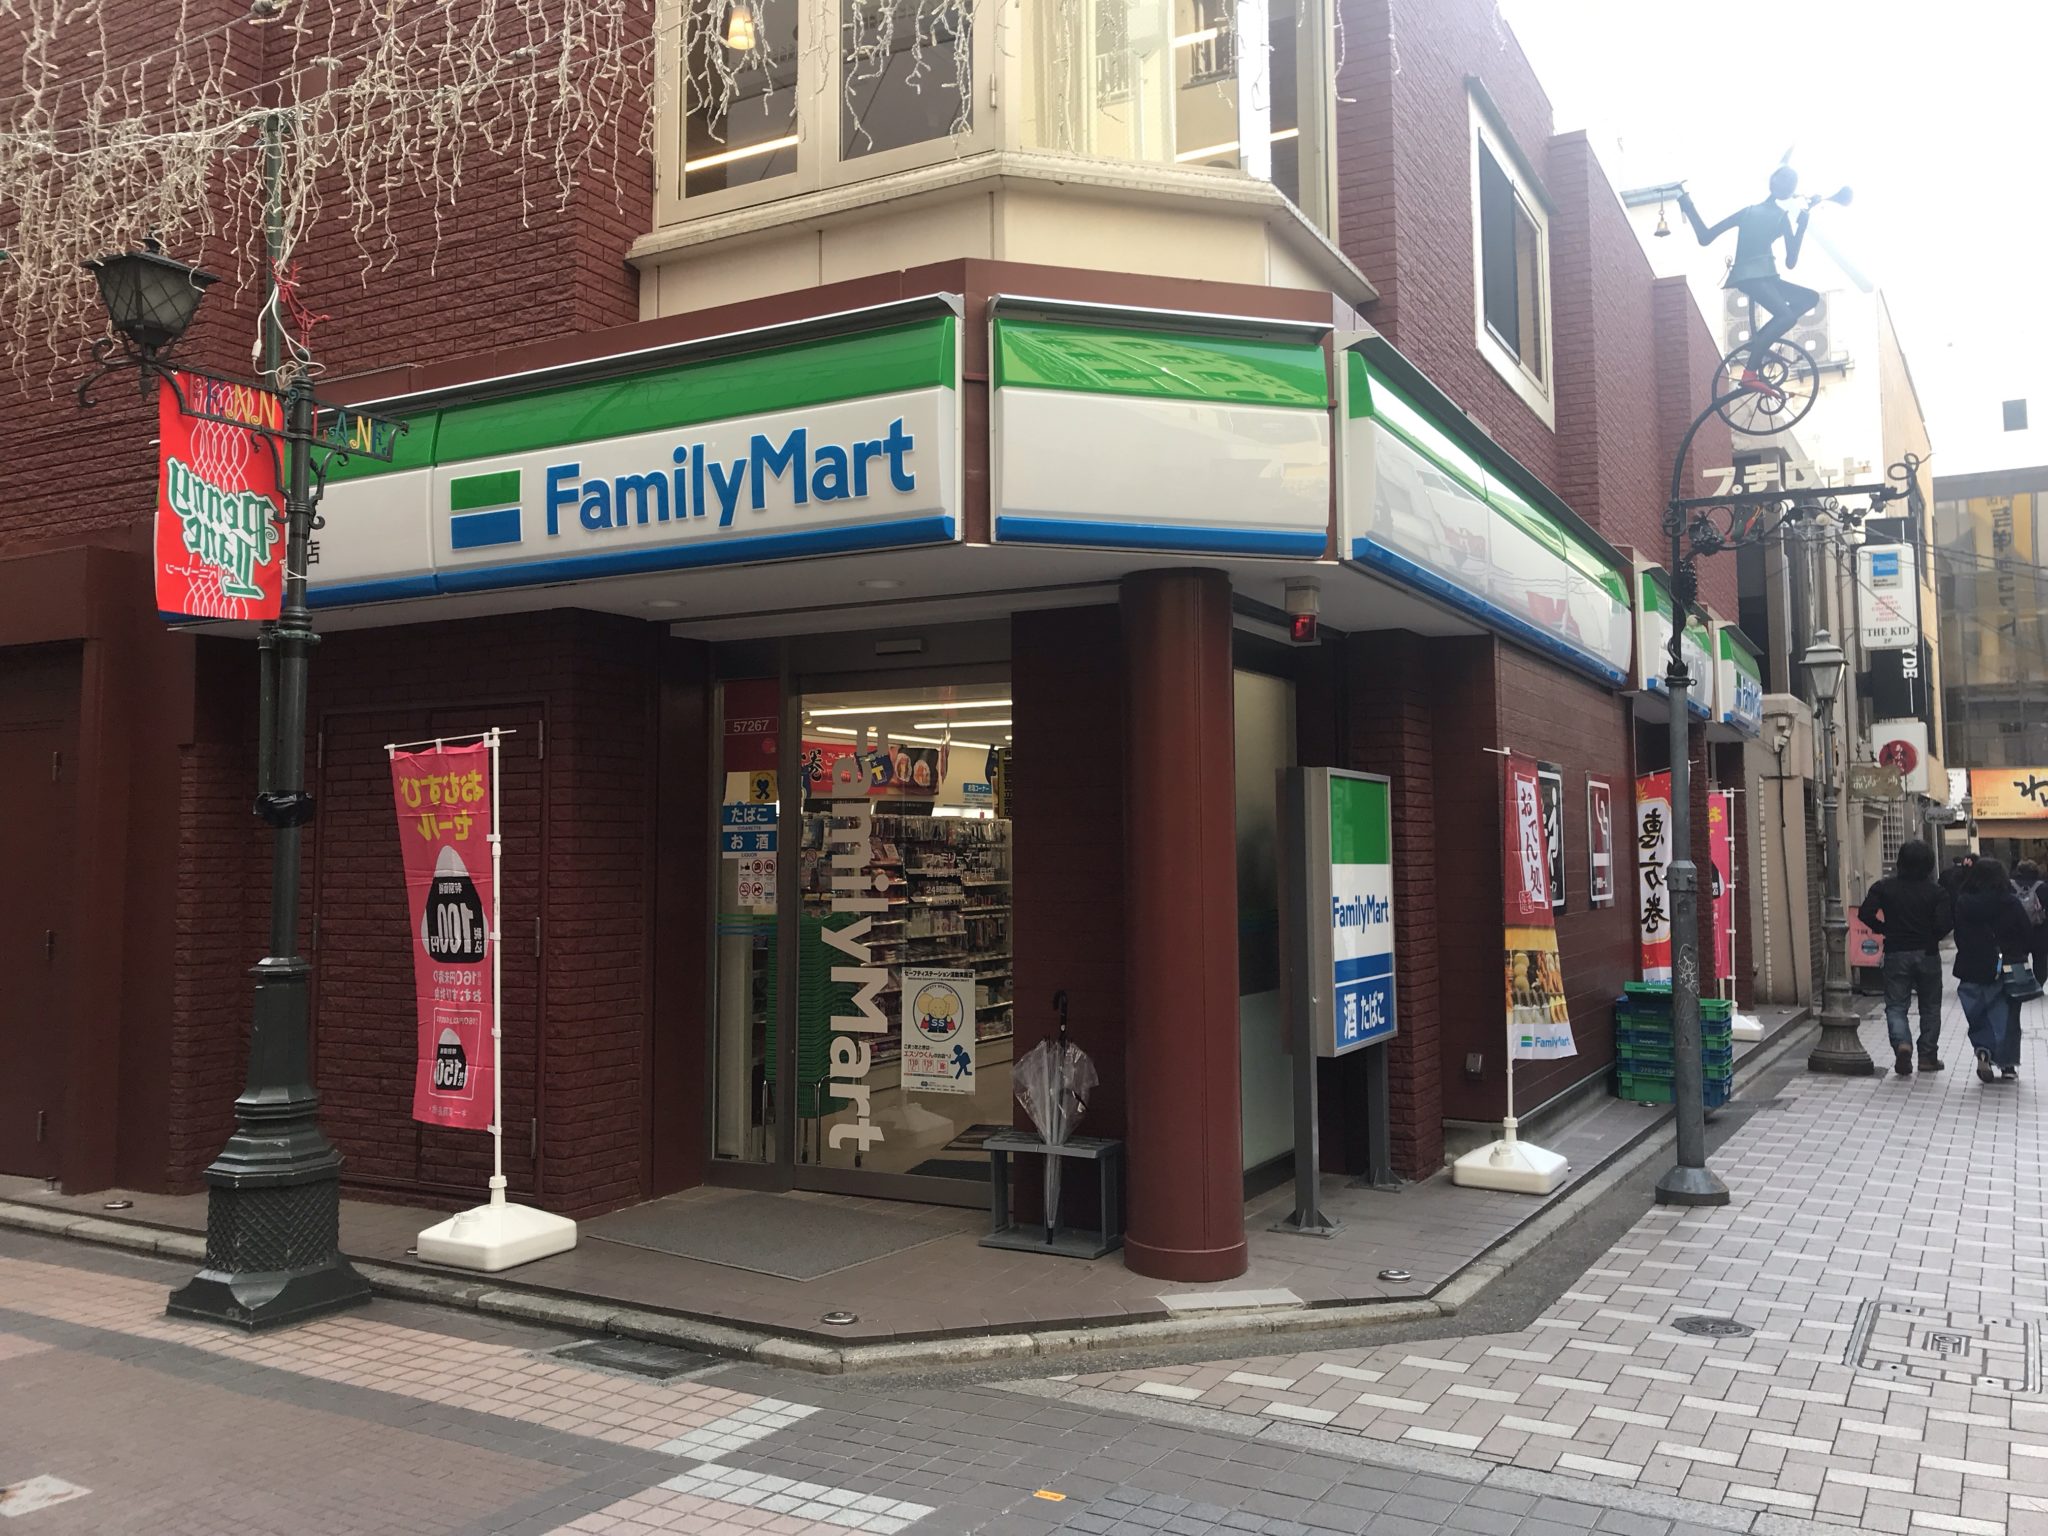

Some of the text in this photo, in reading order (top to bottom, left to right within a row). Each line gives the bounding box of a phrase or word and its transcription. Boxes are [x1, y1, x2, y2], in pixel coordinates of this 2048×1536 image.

[546, 416, 916, 536] FamilyMart
[1867, 626, 1910, 637] THE KID
[733, 720, 769, 732] 57267
[731, 807, 768, 823] たばこ
[1332, 895, 1389, 933] FamilyMart
[1343, 989, 1385, 1039] 酒 たばこ
[931, 1019, 945, 1027] SS
